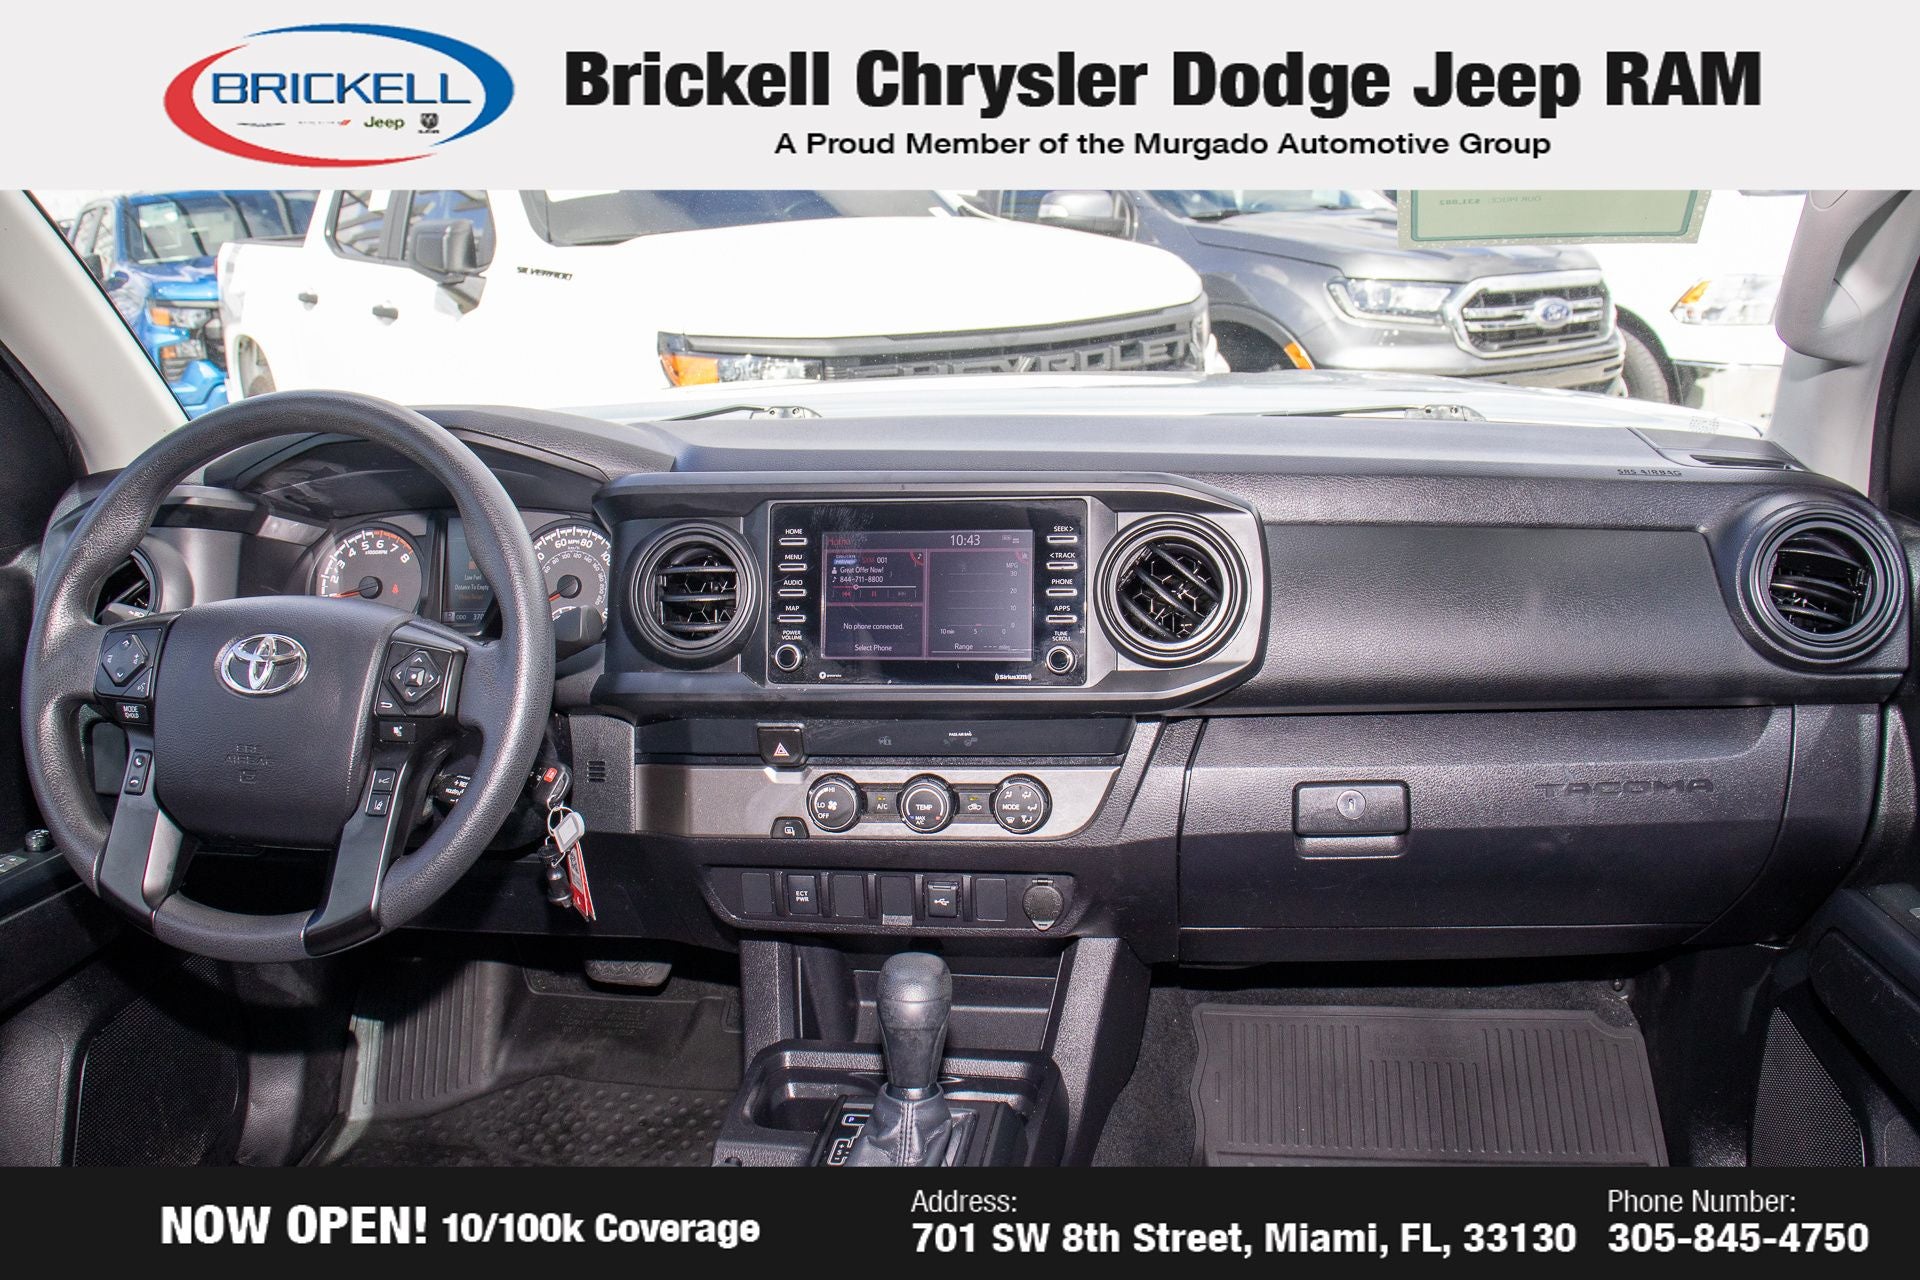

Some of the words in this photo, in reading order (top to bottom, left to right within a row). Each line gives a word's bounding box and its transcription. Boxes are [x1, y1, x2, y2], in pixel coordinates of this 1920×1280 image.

[376, 540, 385, 549] 6
[555, 539, 567, 549] 60
[580, 539, 593, 549] 80
[950, 534, 980, 546] 10:43
[361, 541, 370, 550] 5
[390, 543, 399, 552] 7
[348, 547, 357, 558] 4
[400, 553, 410, 563] 8
[854, 623, 871, 631] phone
[954, 642, 973, 650] Range
[123, 704, 139, 713] MODE
[1534, 778, 1714, 798] TACOMA
[817, 801, 826, 809] LO
[1002, 803, 1020, 811] MODE
